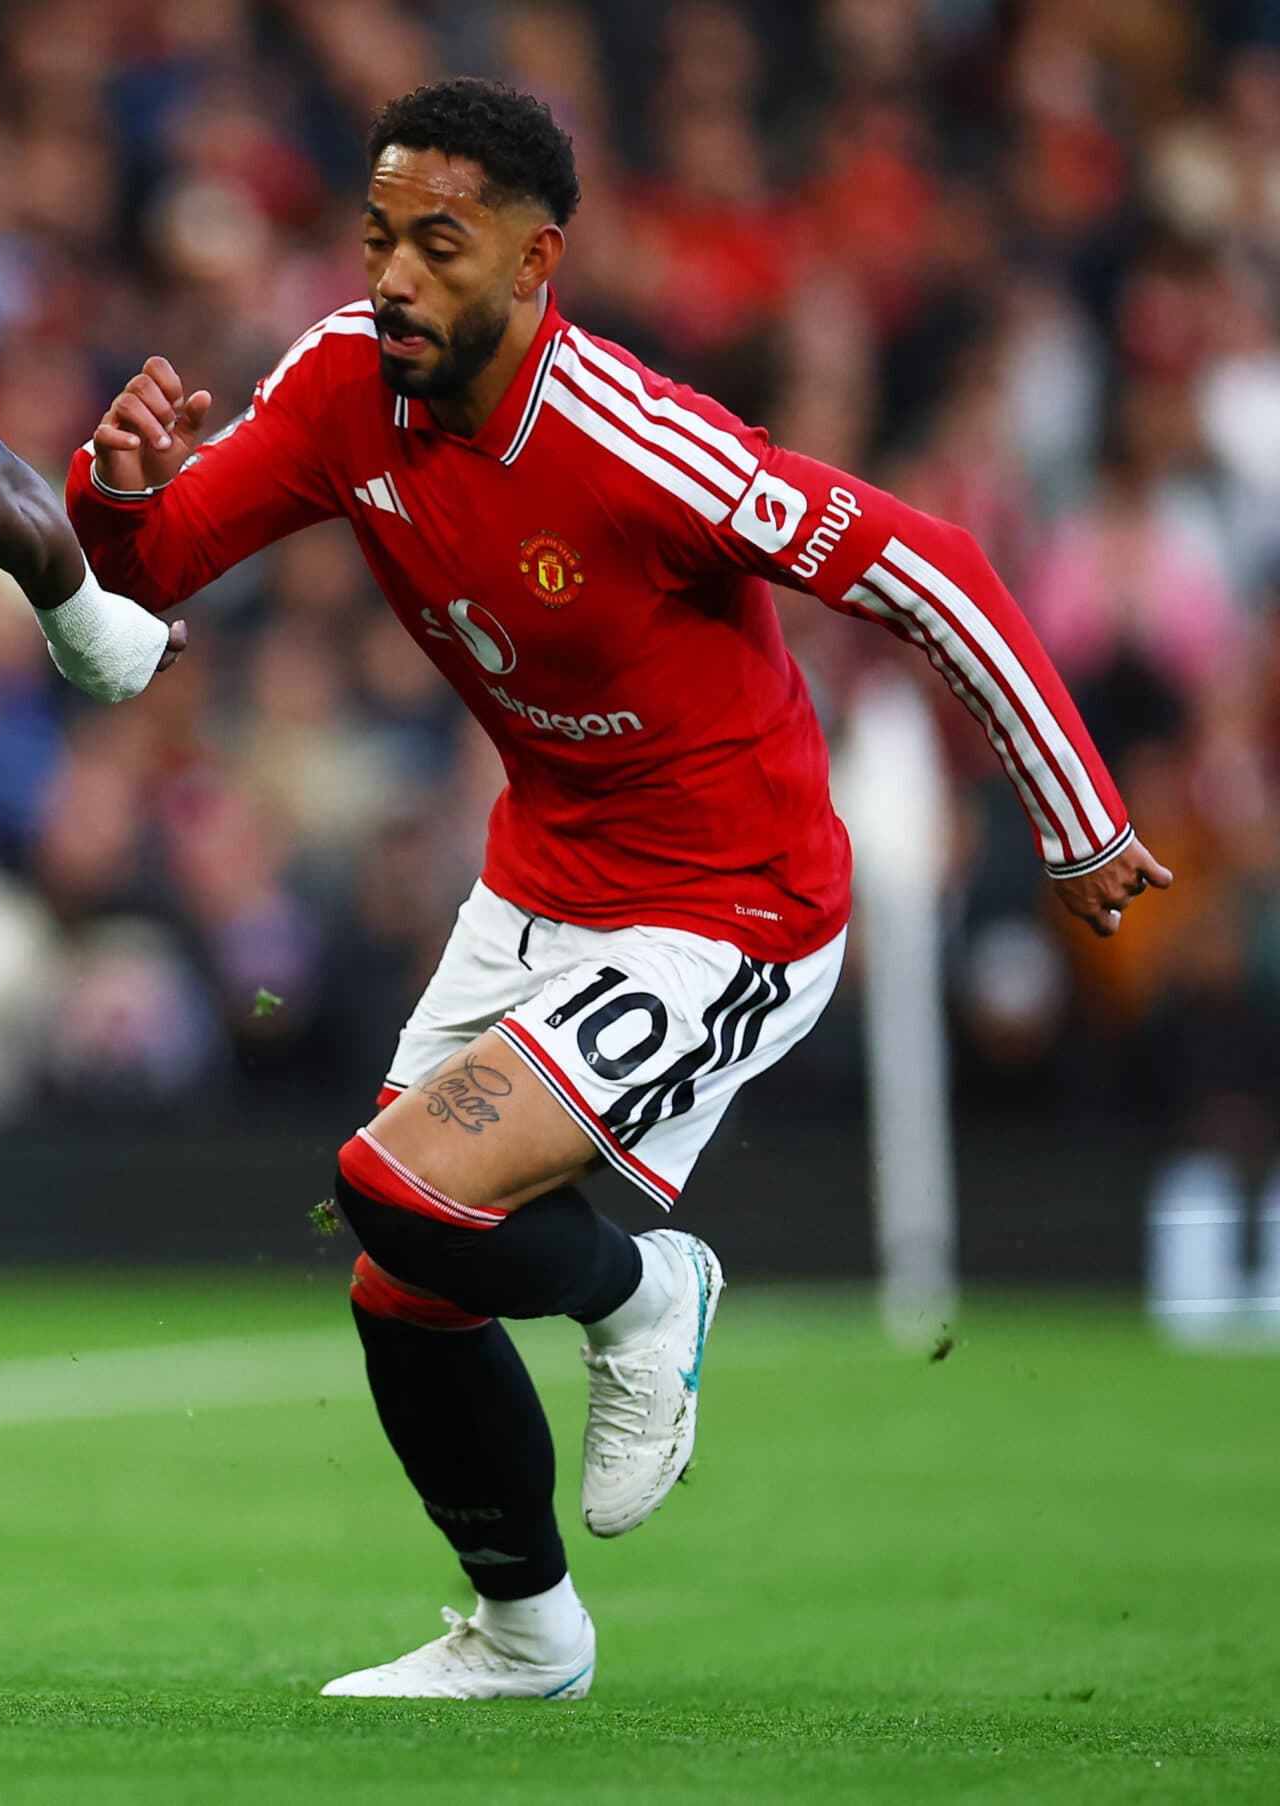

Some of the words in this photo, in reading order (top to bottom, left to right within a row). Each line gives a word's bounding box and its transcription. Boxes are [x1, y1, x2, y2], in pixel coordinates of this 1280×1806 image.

[790, 486, 863, 579] umup
[486, 684, 644, 742] dragon
[543, 966, 668, 1081] 10
